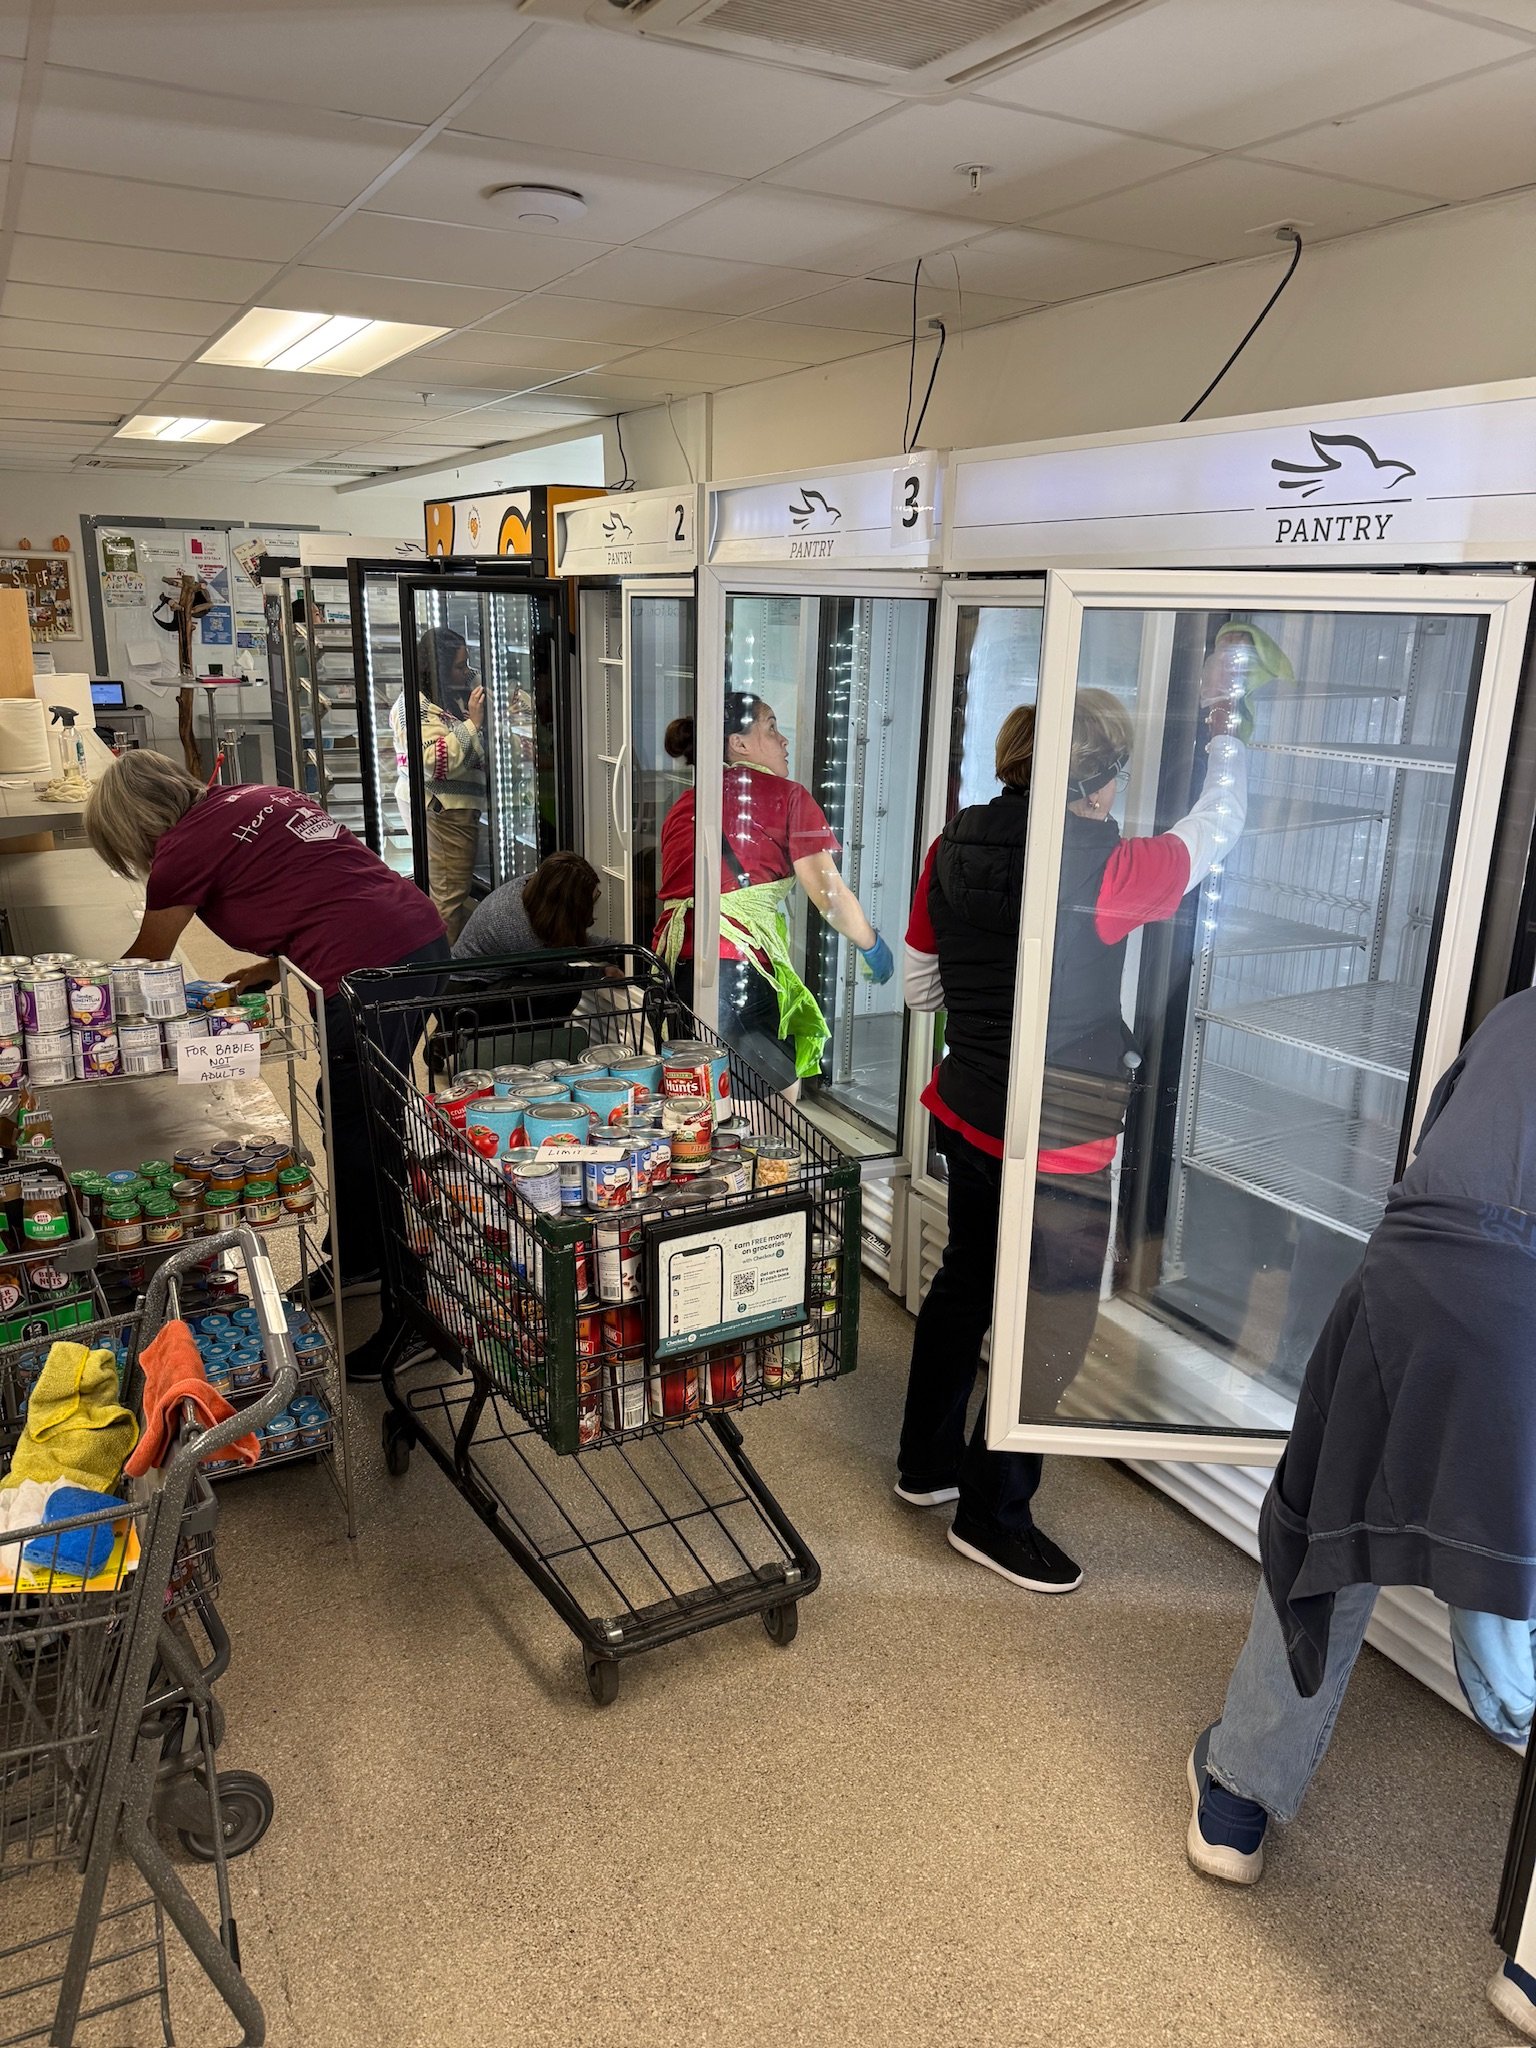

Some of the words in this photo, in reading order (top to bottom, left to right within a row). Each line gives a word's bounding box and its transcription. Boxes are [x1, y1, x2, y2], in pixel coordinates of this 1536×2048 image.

[902, 476, 920, 528] 3
[674, 504, 685, 541] 2
[1275, 513, 1393, 544] PANTRY
[789, 539, 834, 559] PANTRY
[607, 551, 632, 565] PANTRY
[231, 804, 275, 843] Hero
[184, 1044, 208, 1057] FOR
[215, 1043, 255, 1055] BABIES
[209, 1056, 234, 1066] NOT
[200, 1068, 246, 1081] ADULTS
[666, 1079, 699, 1094] Hunt's
[734, 1241, 750, 1250] Earn
[751, 1237, 767, 1246] FREE
[768, 1231, 793, 1242] money
[752, 1240, 785, 1255] groceries
[753, 1252, 775, 1262] Checkout
